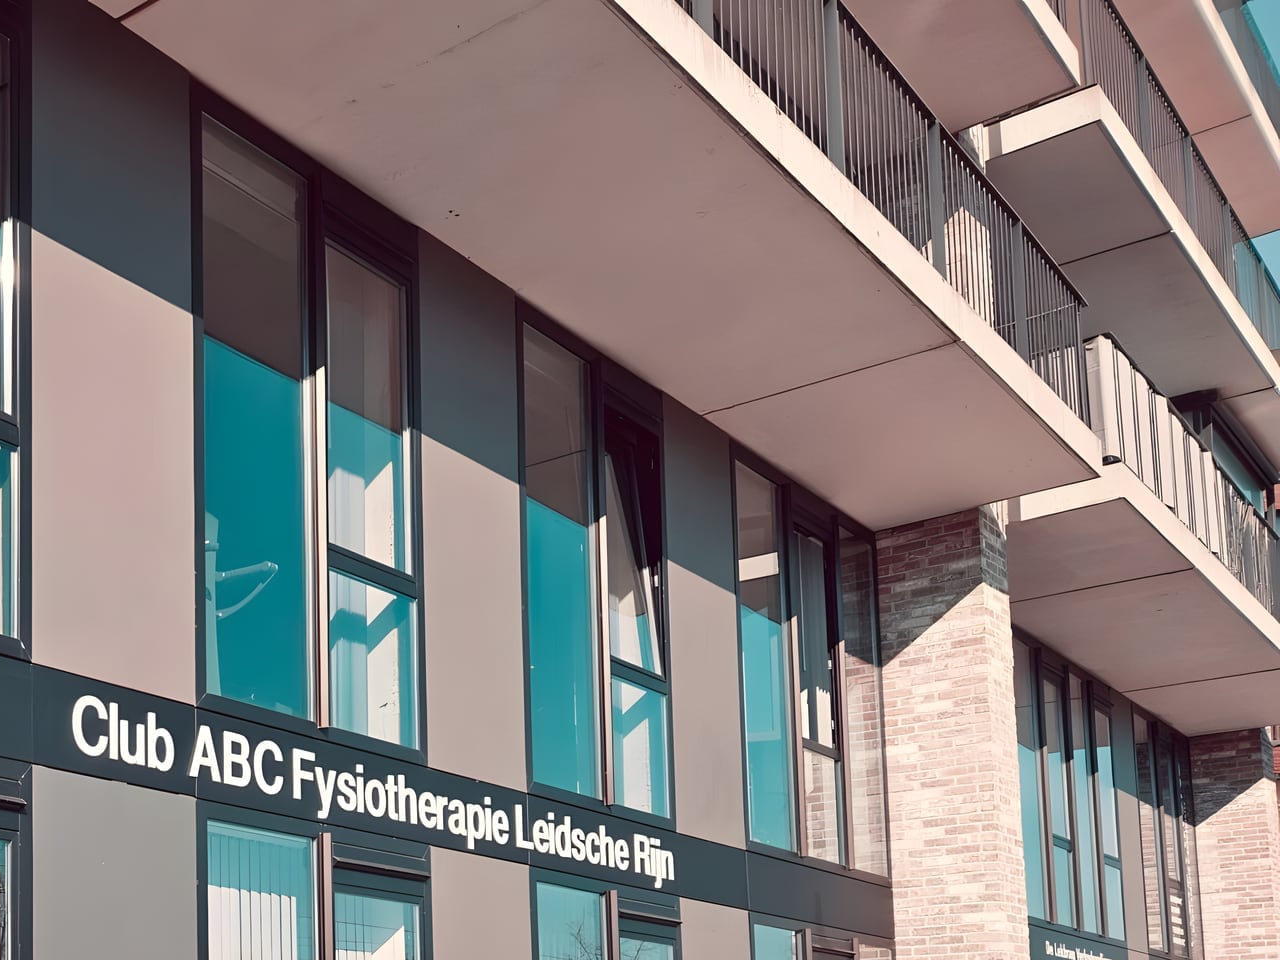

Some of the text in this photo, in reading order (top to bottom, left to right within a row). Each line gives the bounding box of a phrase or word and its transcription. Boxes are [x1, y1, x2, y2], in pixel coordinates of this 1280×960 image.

[71, 694, 675, 889] Club ABC Fysiotherapie Leidsche Rijn
